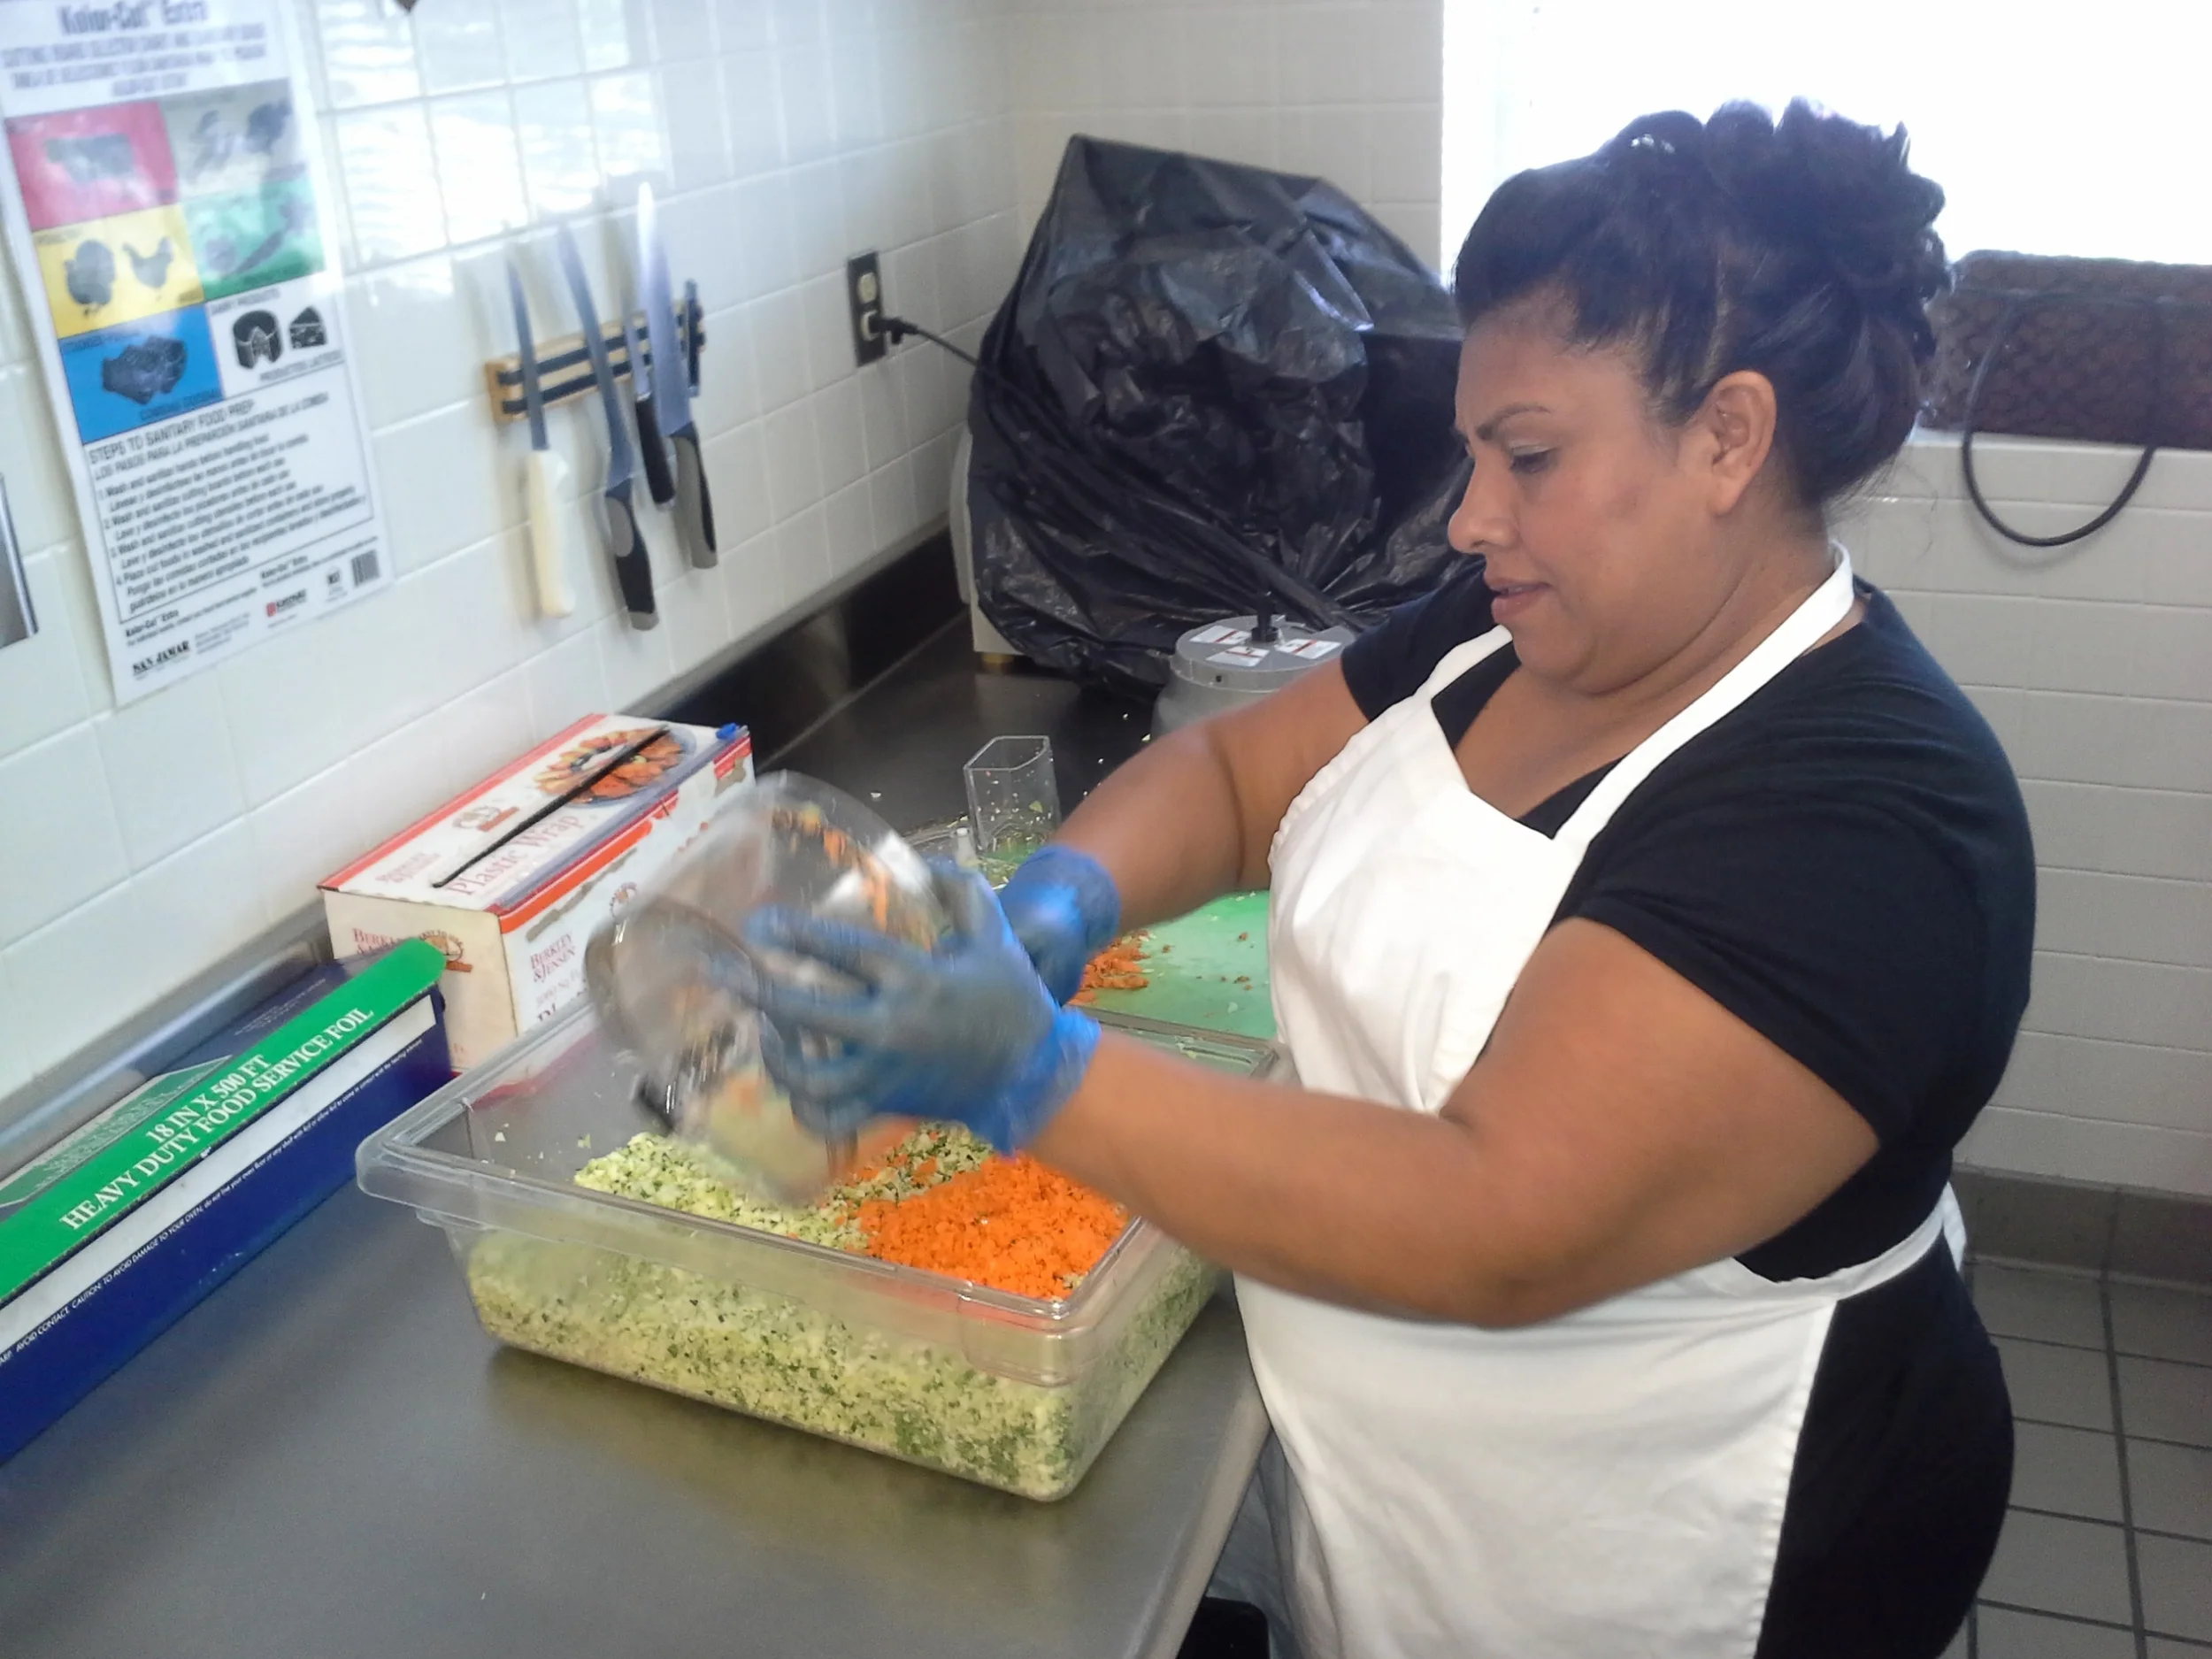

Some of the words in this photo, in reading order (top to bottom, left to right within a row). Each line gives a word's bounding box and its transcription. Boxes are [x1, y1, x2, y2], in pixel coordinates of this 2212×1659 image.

[88, 440, 125, 465] STEPS
[127, 434, 143, 451] TO
[143, 418, 196, 446] SANITARY
[196, 407, 228, 429] FOOD
[443, 850, 528, 895] Plastic
[506, 815, 585, 848] Wrap
[60, 1171, 139, 1229] HEAVY
[134, 1127, 192, 1176] DUTY
[193, 1088, 257, 1133] FOOD
[251, 1031, 333, 1092] SERVICE
[325, 1010, 373, 1043] FOIL
[147, 1124, 174, 1143] 18
[166, 1106, 199, 1128] IN
[192, 1094, 215, 1111] X
[211, 1073, 246, 1099] 500
[239, 1055, 271, 1078] FT
[14, 1331, 37, 1352] AVOID
[103, 1273, 112, 1285] TO
[111, 1258, 133, 1278] AVOID
[132, 1239, 158, 1263] DAMAGE
[159, 1232, 168, 1242] TO
[168, 1218, 186, 1235] YOUR
